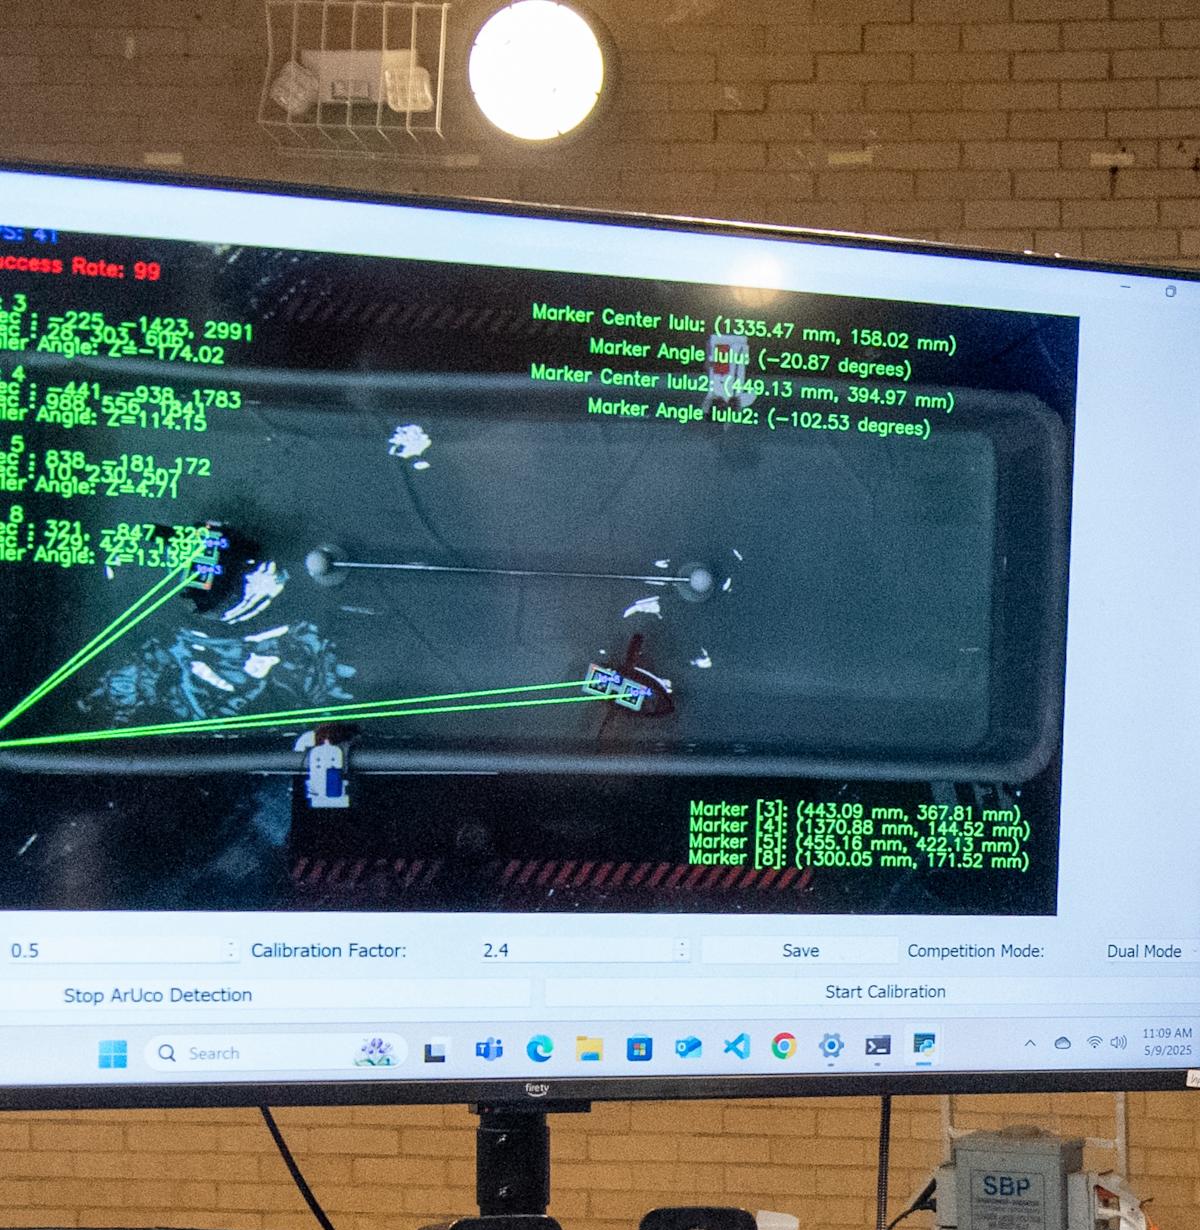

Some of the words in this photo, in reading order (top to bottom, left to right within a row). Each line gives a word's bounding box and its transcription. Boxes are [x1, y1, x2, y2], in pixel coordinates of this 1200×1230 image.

[72, 256, 124, 279] Rate:
[134, 261, 160, 281] 99
[13, 293, 26, 312] 3
[204, 321, 252, 342] 2991
[532, 303, 594, 323] Marker
[602, 308, 661, 329] Center
[669, 314, 705, 332] lulu:
[714, 315, 795, 339] (1335.47
[803, 328, 841, 345] mm,
[851, 329, 909, 349] 158.02
[917, 335, 957, 356] mm)
[37, 335, 98, 358] Angle:
[590, 338, 651, 357] Marker
[657, 343, 705, 364] Angle
[713, 347, 749, 365] lulu:
[758, 348, 831, 371] (-20.87
[838, 357, 912, 381] degrees)
[12, 364, 26, 382] 4
[531, 363, 593, 382] Marker
[600, 368, 660, 388] Center
[667, 373, 714, 392] lulu2:
[724, 375, 793, 398] (449.13
[801, 384, 839, 403] mm,
[847, 386, 907, 406] 394.97
[915, 392, 955, 413] mm)
[192, 389, 241, 409] 1783
[36, 405, 97, 428] Angle:
[588, 397, 649, 416] Marker
[655, 402, 703, 424] Angle
[712, 408, 759, 425] lulu2:
[767, 407, 850, 431] (-102.53
[858, 416, 931, 440] degrees)
[10, 434, 25, 453] 5
[175, 457, 211, 476] 172
[34, 475, 96, 498] Angle:
[9, 504, 24, 523] 8
[34, 544, 95, 568] Angle:
[690, 800, 748, 817] Marker
[797, 800, 863, 820] (443.09
[871, 806, 909, 822] mm,
[917, 804, 973, 822] 367.81
[982, 804, 1021, 825] mm)
[689, 816, 748, 833] Marker
[796, 816, 874, 836] (1370.88
[881, 822, 918, 838] mm,
[928, 820, 984, 837] 144.52
[992, 820, 1031, 841] mm)
[689, 833, 748, 849] Marker
[796, 832, 863, 852] (455.16
[871, 838, 908, 853] mm,
[916, 836, 974, 852] 422.13
[981, 836, 1020, 857] mm)
[688, 849, 748, 865] Marker
[795, 849, 873, 869] (1300.05
[880, 854, 918, 870] mm,
[927, 852, 983, 869] 171.52
[991, 852, 1029, 872] mm)
[11, 943, 39, 959] 0.5
[251, 942, 342, 959] Calibration
[348, 942, 407, 959] Factor:
[483, 942, 509, 958] 2.4
[783, 943, 820, 959] Save
[908, 943, 995, 963] Competition
[1000, 943, 1045, 959] Mode:
[1107, 943, 1139, 959] Dual
[1143, 943, 1182, 959] Mode
[63, 988, 104, 1006] Stop
[111, 987, 163, 1003] ArUco
[170, 987, 252, 1003] Detection
[826, 984, 863, 1000] Start
[868, 983, 946, 1000] Calibration
[1143, 1027, 1172, 1039] 11:09
[1175, 1027, 1192, 1039] AM
[189, 1046, 240, 1061] Search
[1144, 1044, 1192, 1057] 5/9/2025
[984, 1175, 1031, 1196] SBP
